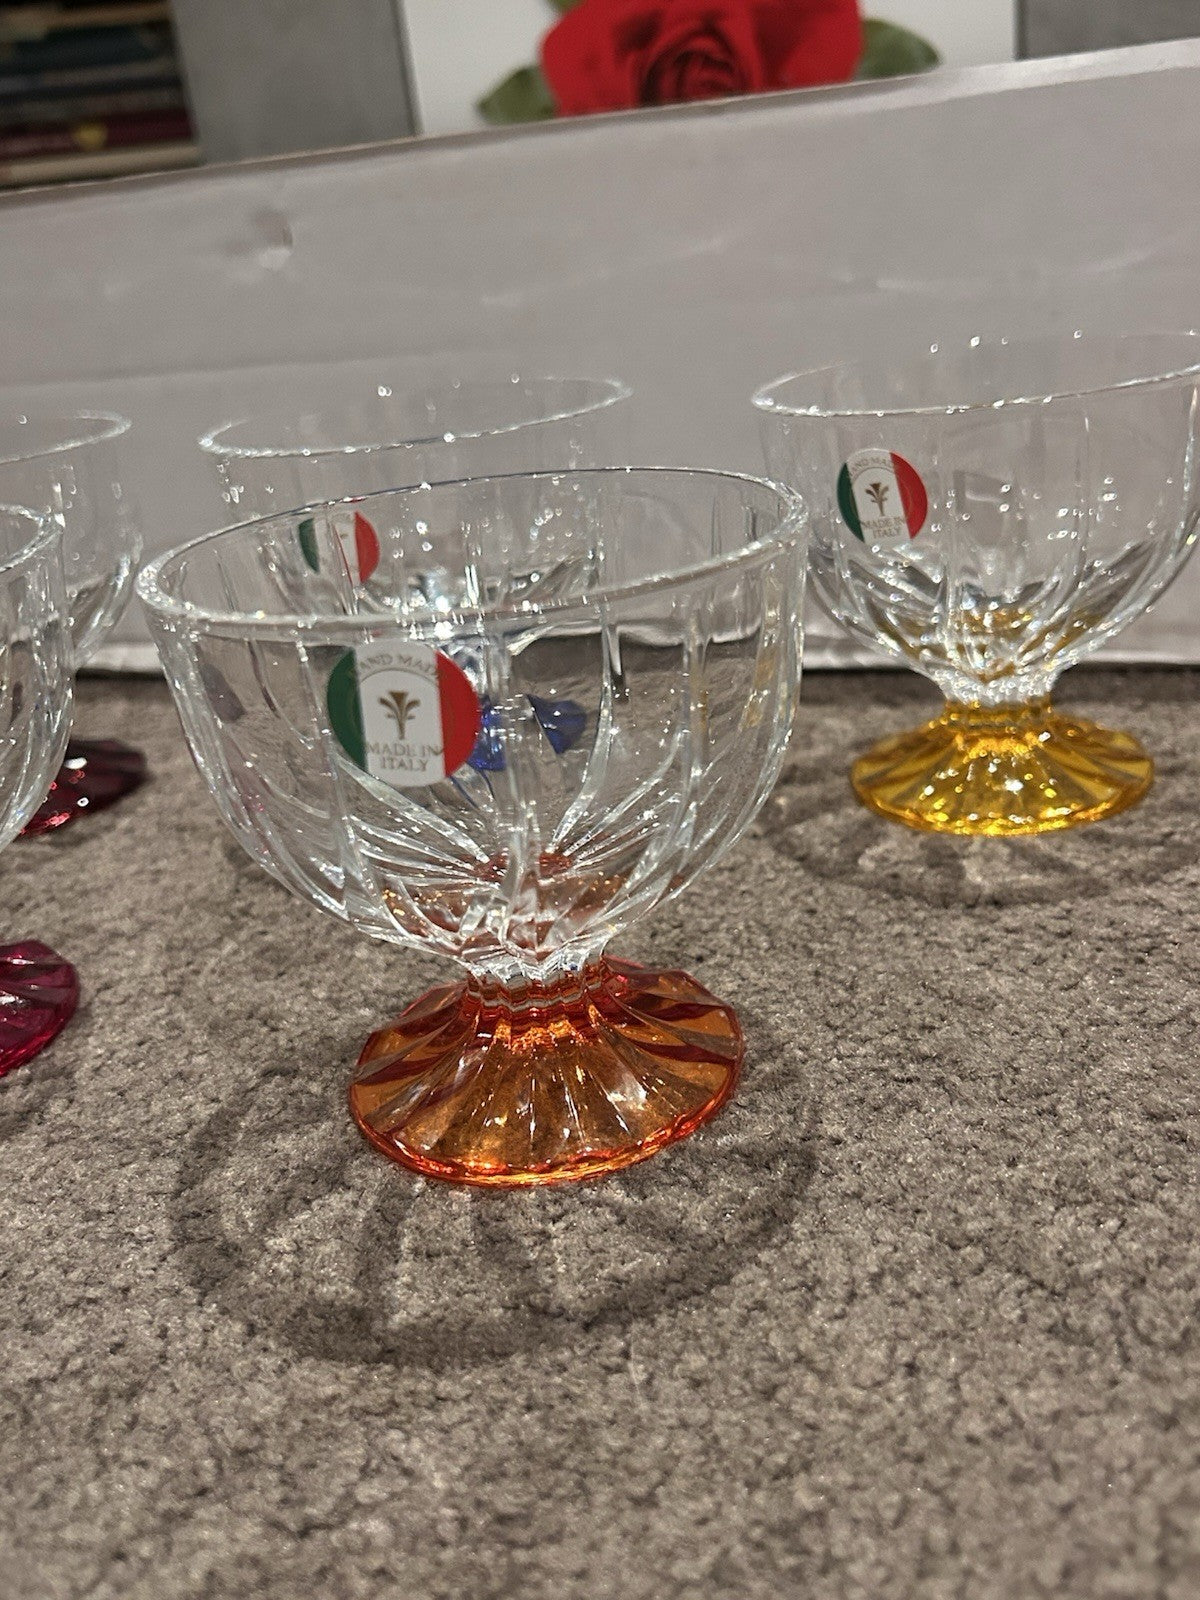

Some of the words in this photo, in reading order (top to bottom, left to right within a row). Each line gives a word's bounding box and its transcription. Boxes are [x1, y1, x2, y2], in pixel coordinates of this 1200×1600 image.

[873, 527, 901, 538] ITALY
[366, 742, 417, 757] MADE
[422, 744, 444, 757] IN
[381, 757, 429, 772] ITALY
